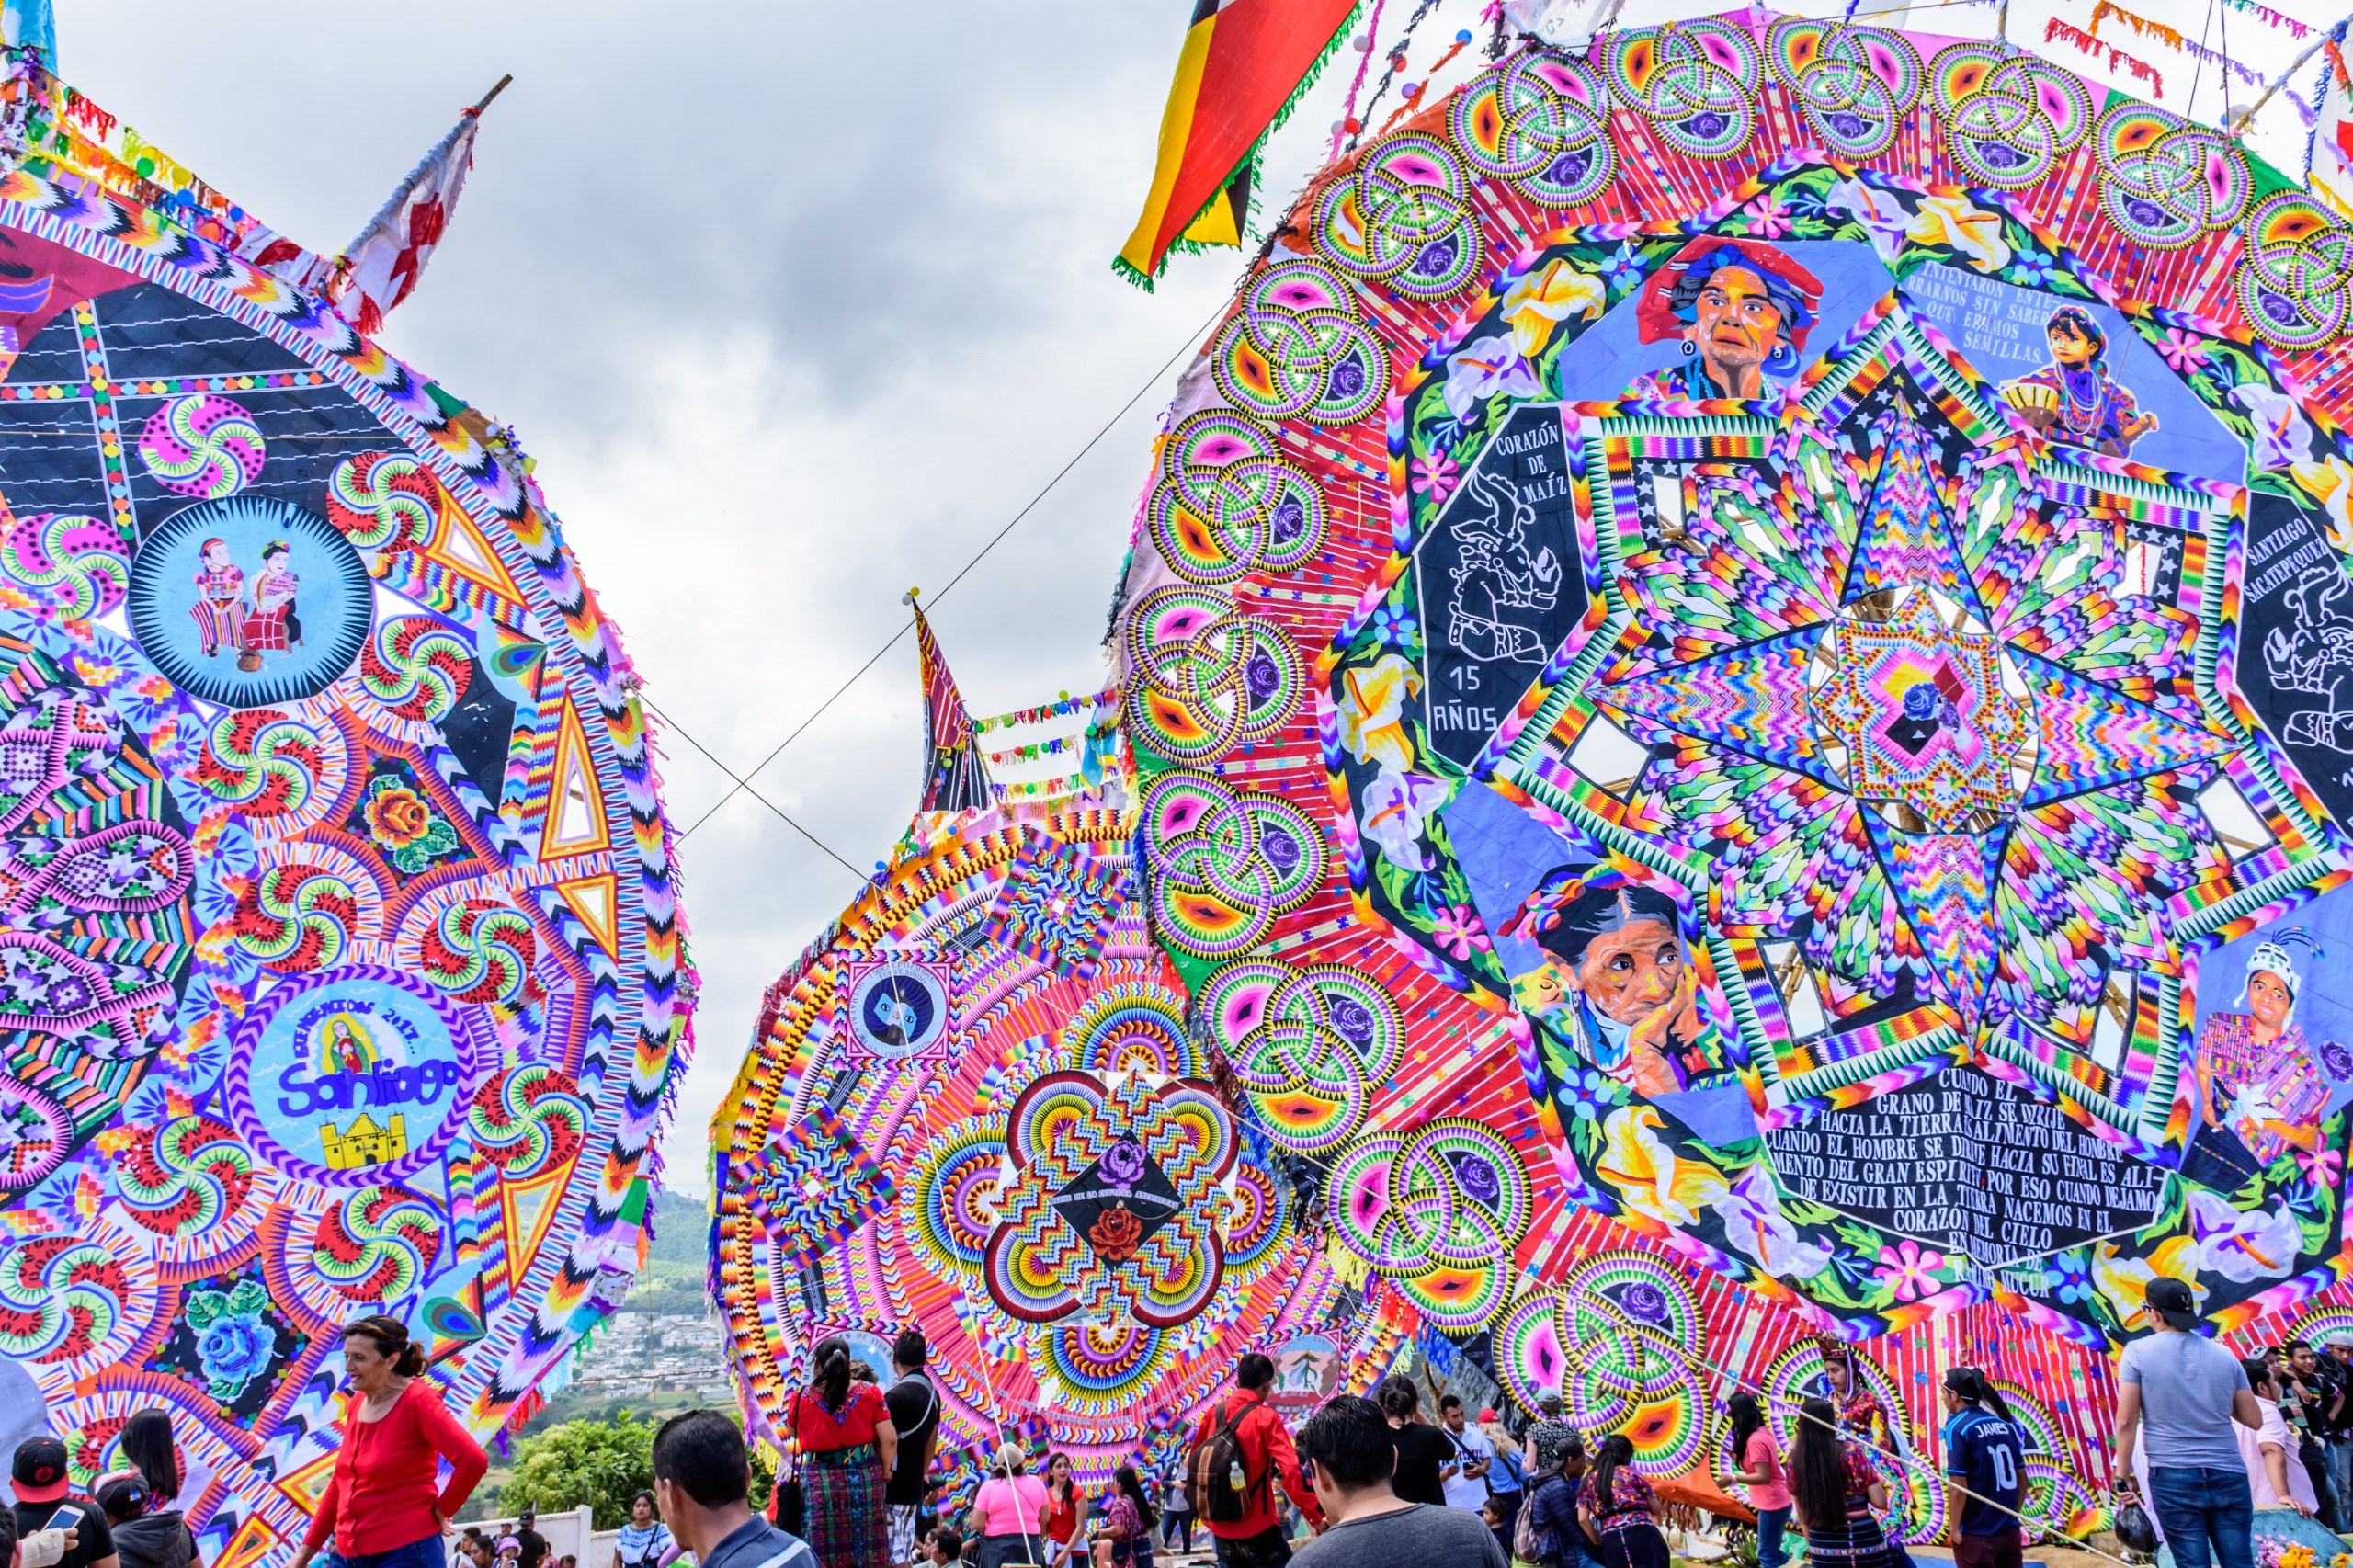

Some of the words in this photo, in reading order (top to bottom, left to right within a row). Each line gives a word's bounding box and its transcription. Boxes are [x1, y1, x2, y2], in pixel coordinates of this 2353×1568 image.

[1922, 261, 2006, 299] INTENTARON
[1907, 275, 1968, 307] RRARNOS
[1973, 295, 2003, 317] SIN
[2007, 303, 2050, 326] SABER
[1926, 301, 1956, 323] QUE
[1963, 331, 2043, 364] SEMILLAS.
[1495, 420, 1559, 456] CORAZÓN
[1527, 454, 1547, 475] DE
[1522, 471, 1567, 504] MAÍZ
[2246, 518, 2308, 566] SANTIAGO
[2243, 538, 2330, 604] SACATEPEQUEZ
[1449, 665, 1480, 690] 15
[1433, 699, 1497, 732] AÑOS
[884, 1040, 932, 1059] CORRPTOS
[277, 1058, 461, 1117] Santiago
[1938, 1067, 1989, 1097] CUANDO
[1995, 1080, 2018, 1103] EL
[1877, 1093, 1935, 1115] GRANO
[1942, 1091, 1961, 1113] DE
[1998, 1101, 2017, 1122] SE
[1820, 1110, 1865, 1136] HACIA
[1870, 1115, 1893, 1136] LA
[1900, 1112, 1963, 1137] TIERRA
[1972, 1120, 2049, 1149] ALIMENTO
[2052, 1131, 2076, 1154] DEL
[2078, 1133, 2124, 1164] HOMBRE
[1763, 1128, 1821, 1154] CUANDO
[1826, 1133, 1847, 1157] EL
[1852, 1137, 1917, 1161] HOMBRE
[1924, 1136, 1944, 1159] SE
[1990, 1145, 2034, 1174] HACIA
[2042, 1153, 2059, 1176] SU
[2063, 1154, 2098, 1182] FINAL
[2100, 1161, 2115, 1184] ES
[1772, 1152, 1824, 1178] MENTO
[1828, 1158, 1859, 1182] DEL
[1863, 1162, 1911, 1185] GRAN
[1986, 1170, 2014, 1196] POR
[2020, 1176, 2051, 1201] ESO
[2056, 1180, 2101, 1207] CUANDO
[2105, 1186, 2165, 1215] DEJAMOS
[1800, 1177, 1817, 1200] DE
[1822, 1179, 1887, 1209] EXISTIR
[1893, 1186, 1916, 1209] EN
[1923, 1184, 1949, 1208] LA
[1957, 1184, 1997, 1215] TIERRA
[2004, 1197, 2073, 1228] NACEMOS
[2077, 1210, 2091, 1232] EN
[2097, 1210, 2113, 1233] EL
[1893, 1204, 1969, 1233] CORAZÓN
[1973, 1213, 1995, 1240] DEL
[2001, 1221, 2052, 1250] CIELO
[1948, 1232, 1970, 1255] EN
[1970, 1234, 2020, 1270] MEMORIA
[2025, 1248, 2044, 1273] DE
[2000, 1270, 2050, 1298] MUCUR
[1974, 1422, 2009, 1438] JAMES
[1986, 1443, 2018, 1492] 10
